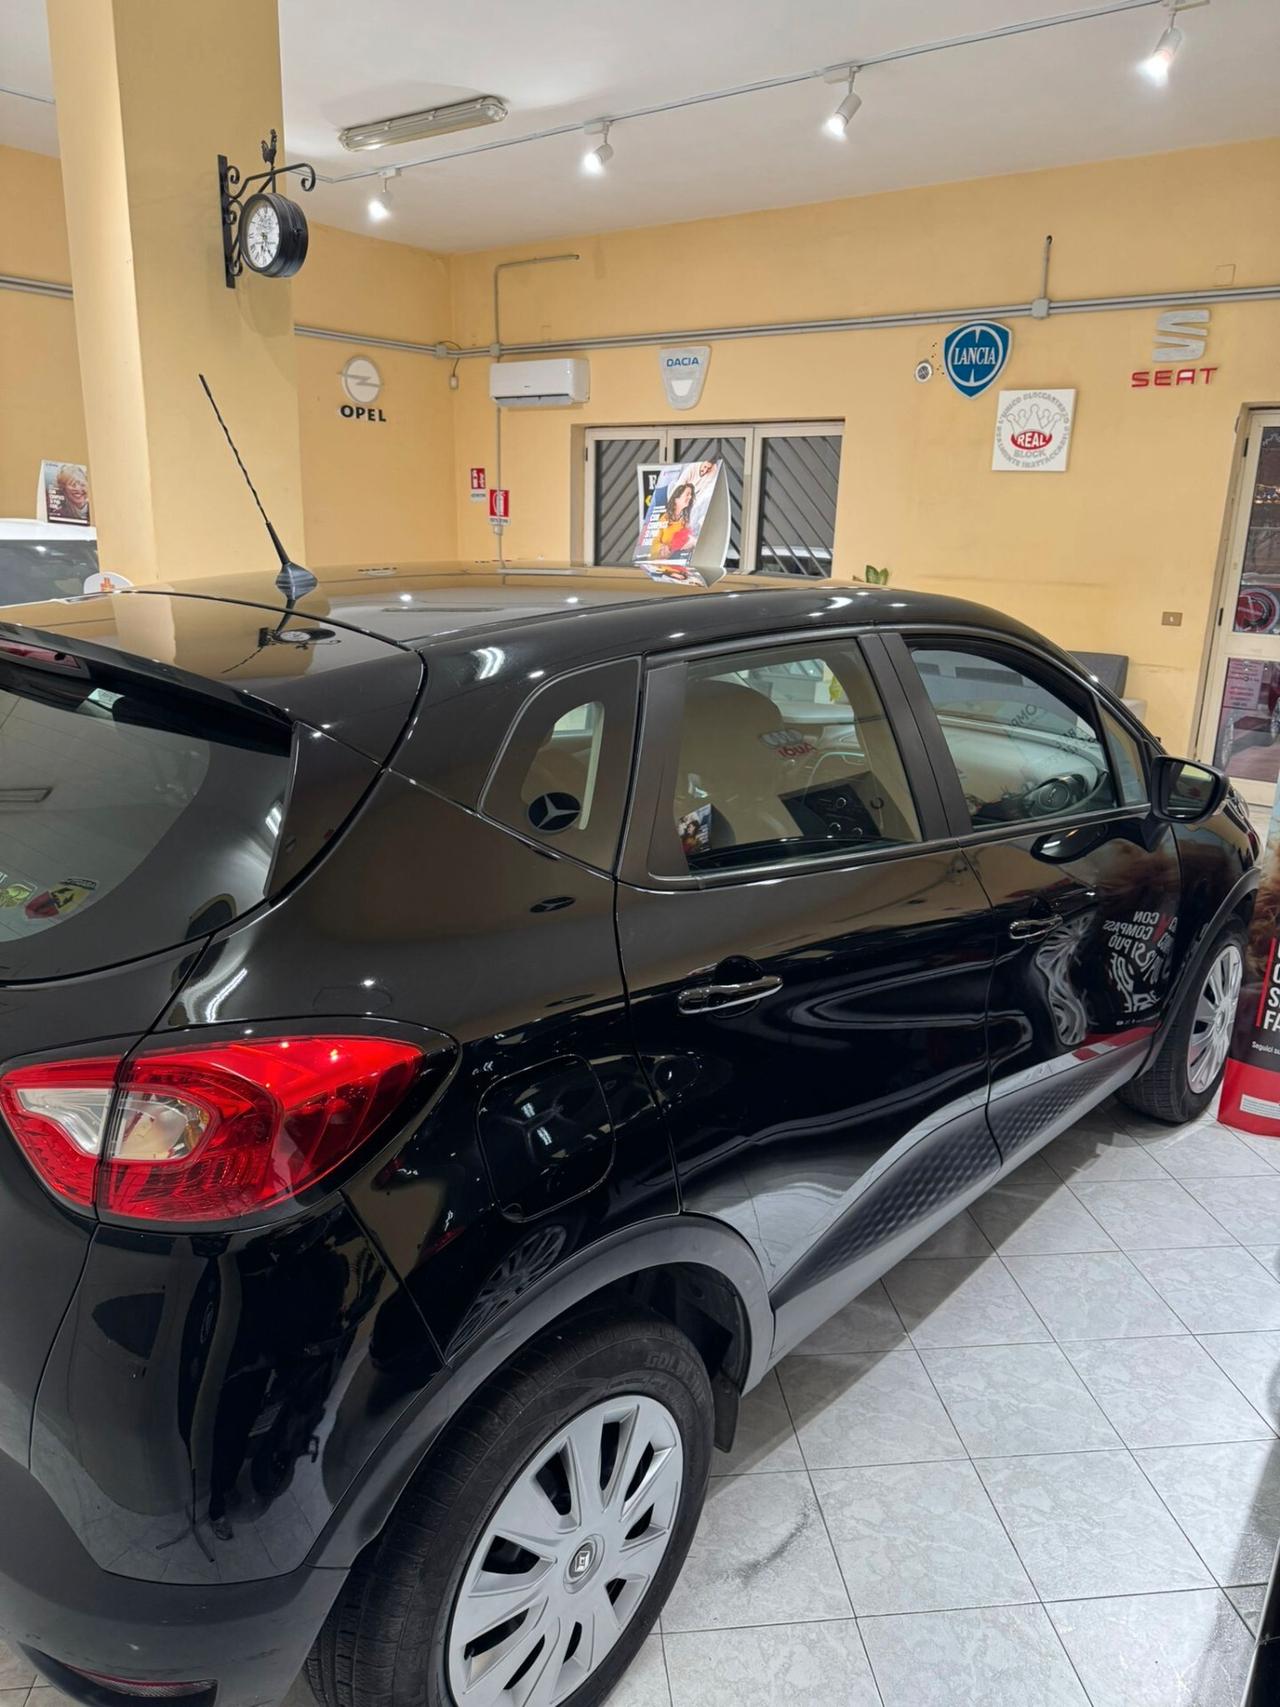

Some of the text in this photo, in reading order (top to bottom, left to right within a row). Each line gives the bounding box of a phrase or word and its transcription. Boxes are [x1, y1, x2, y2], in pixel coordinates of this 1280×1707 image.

[666, 356, 699, 367] DACIA
[953, 346, 996, 365] LANCIA
[1131, 367, 1218, 387] SEAT
[340, 404, 387, 422] OPEL
[1017, 432, 1047, 448] REAL
[1013, 450, 1047, 459] BLOCK
